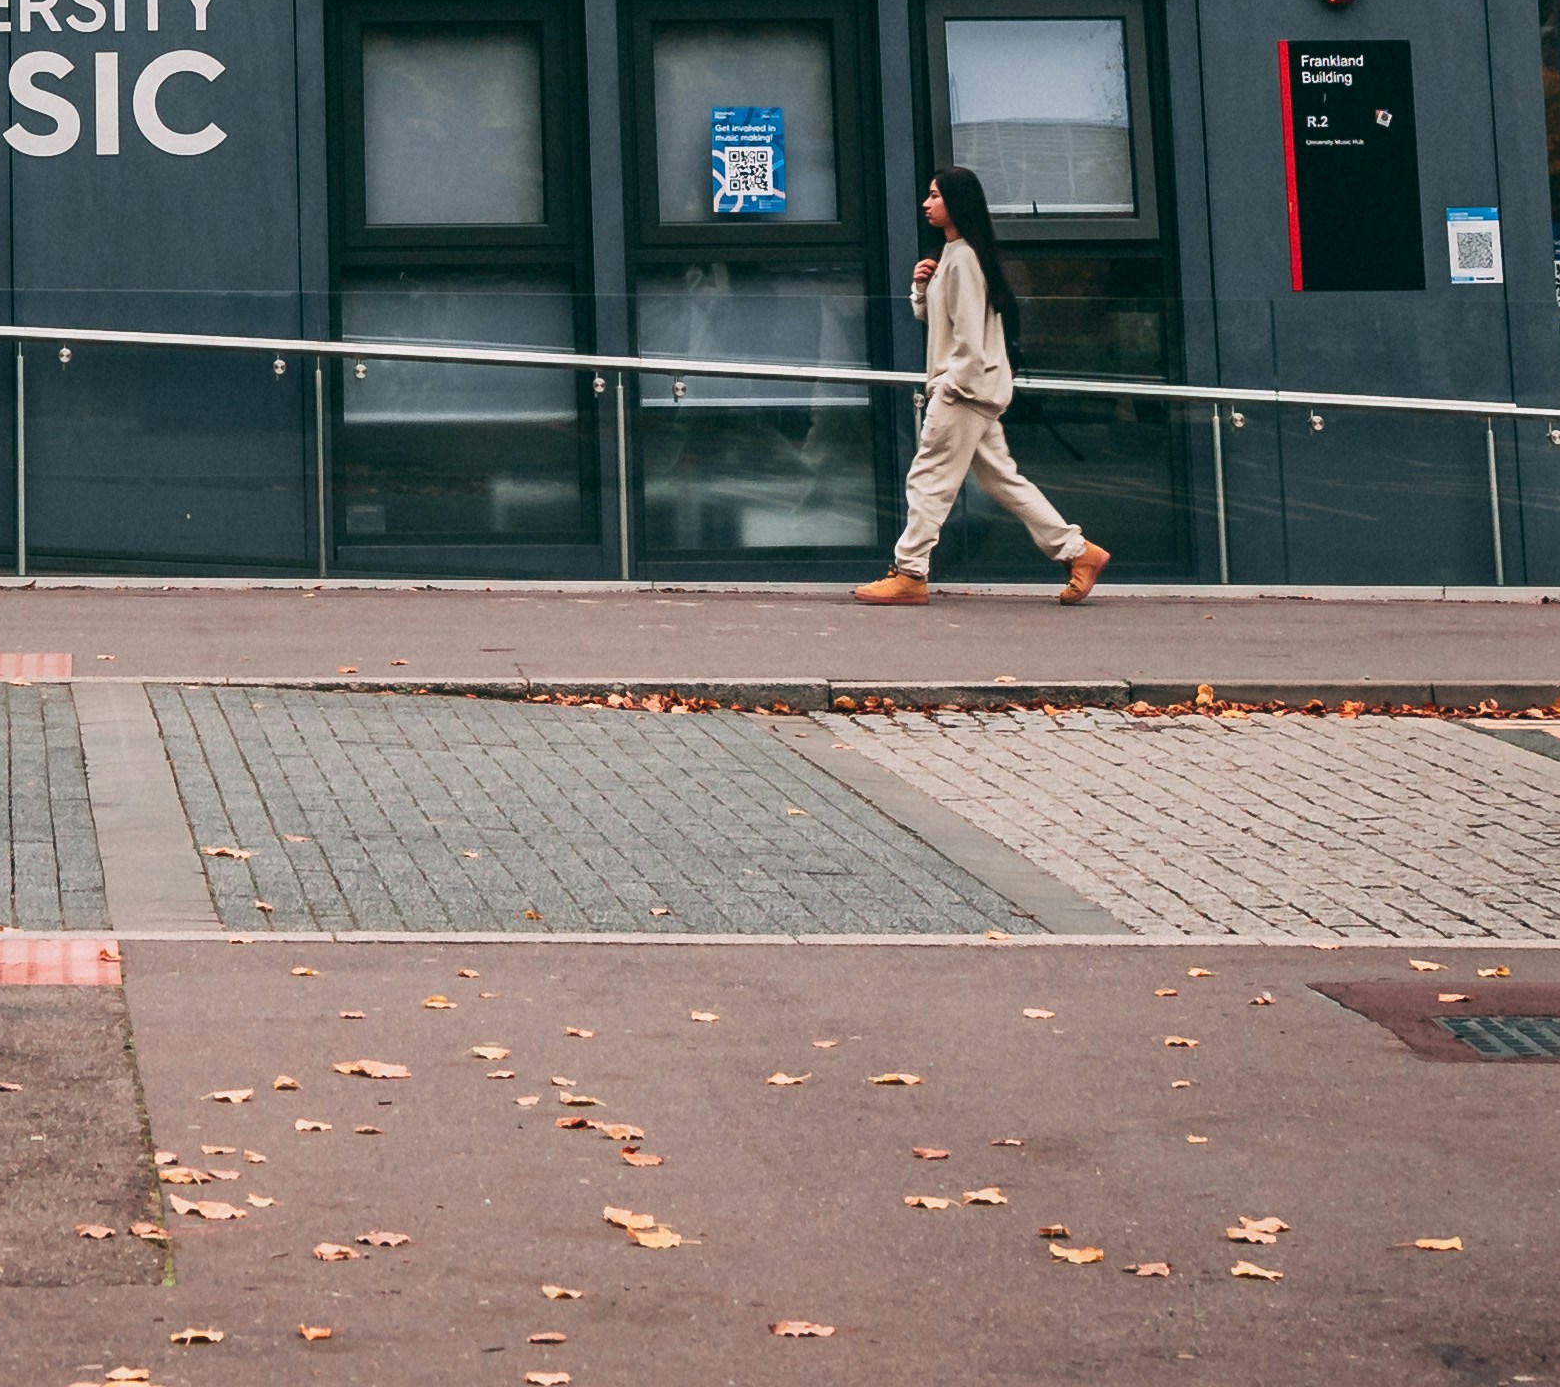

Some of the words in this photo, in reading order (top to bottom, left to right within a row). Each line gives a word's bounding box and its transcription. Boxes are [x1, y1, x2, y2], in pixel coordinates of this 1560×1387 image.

[1300, 54, 1364, 68] Frankland
[1301, 71, 1353, 86] Building
[1306, 115, 1329, 128] R.2
[714, 124, 730, 133] Get
[731, 124, 766, 133] involved
[767, 124, 777, 132] in
[740, 134, 773, 144] making!
